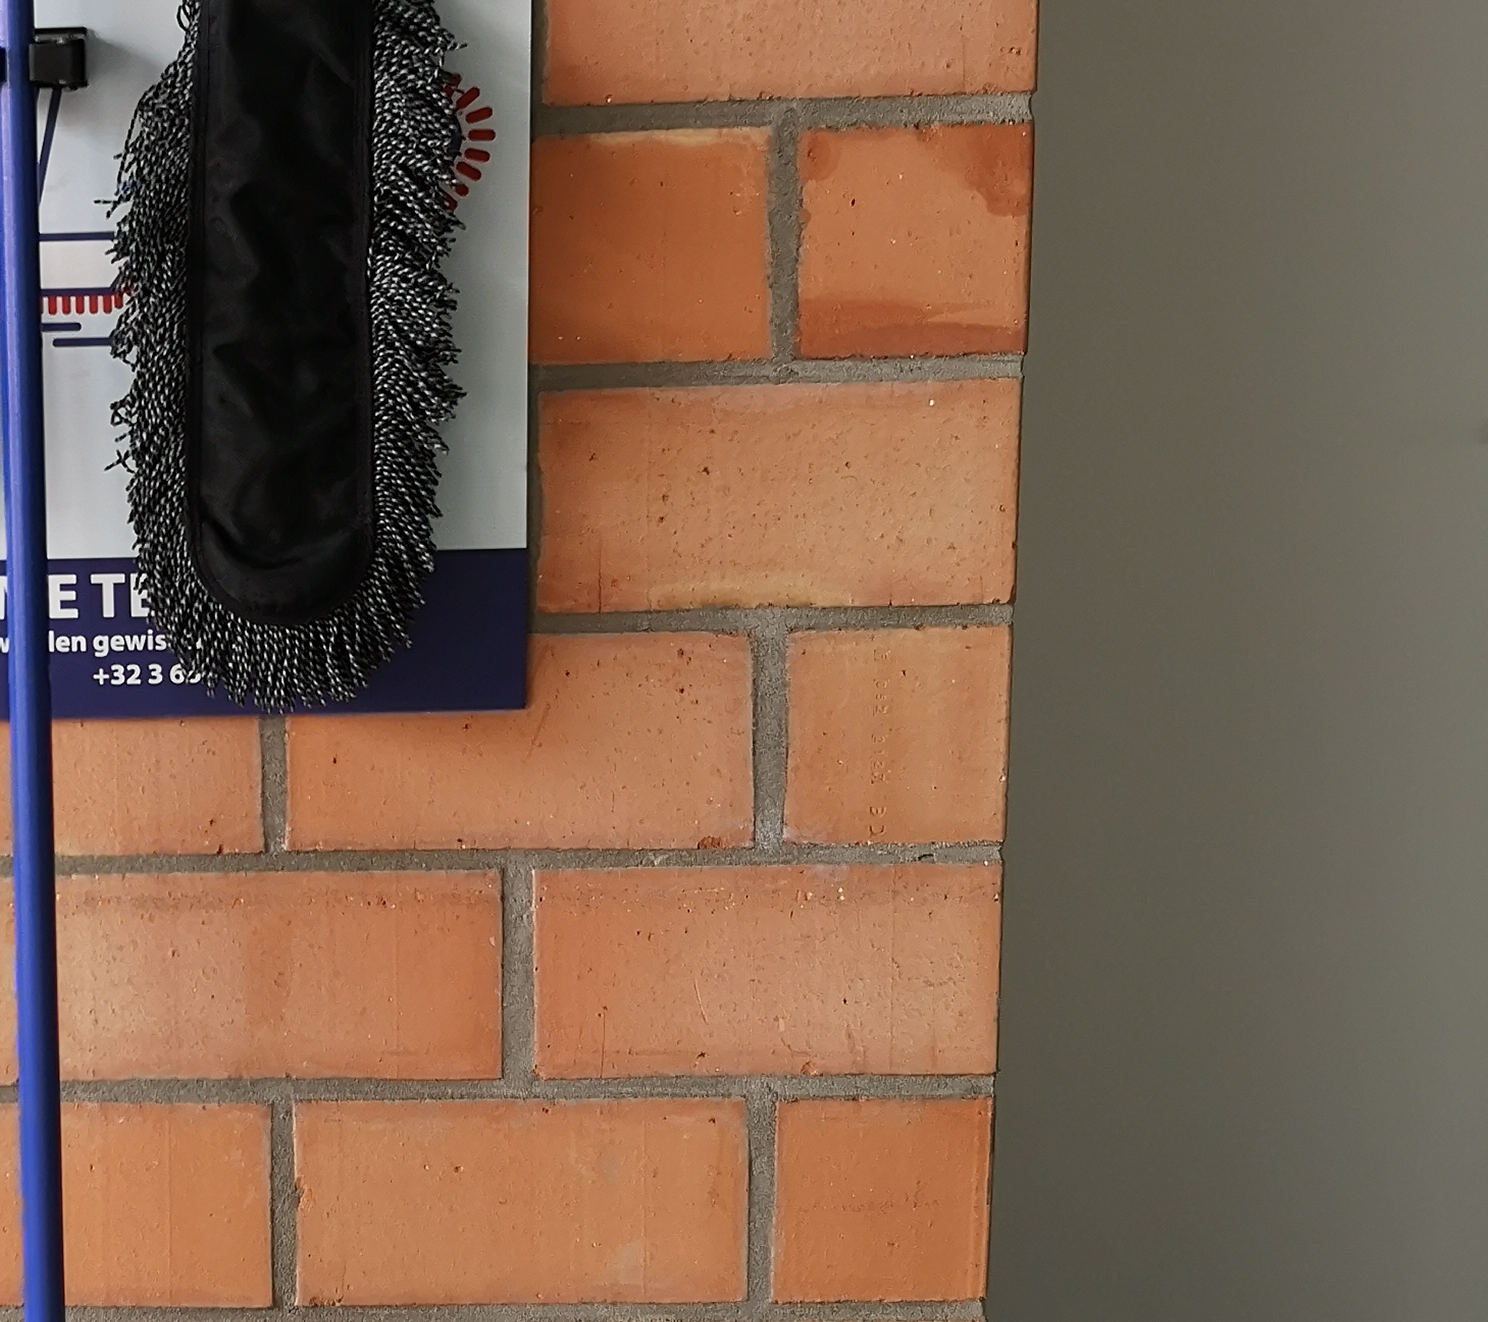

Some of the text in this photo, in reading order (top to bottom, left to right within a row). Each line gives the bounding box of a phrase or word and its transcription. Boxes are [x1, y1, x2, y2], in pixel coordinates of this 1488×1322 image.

[92, 628, 169, 658] gewis
[92, 663, 142, 685] +32
[148, 663, 163, 685] 3
